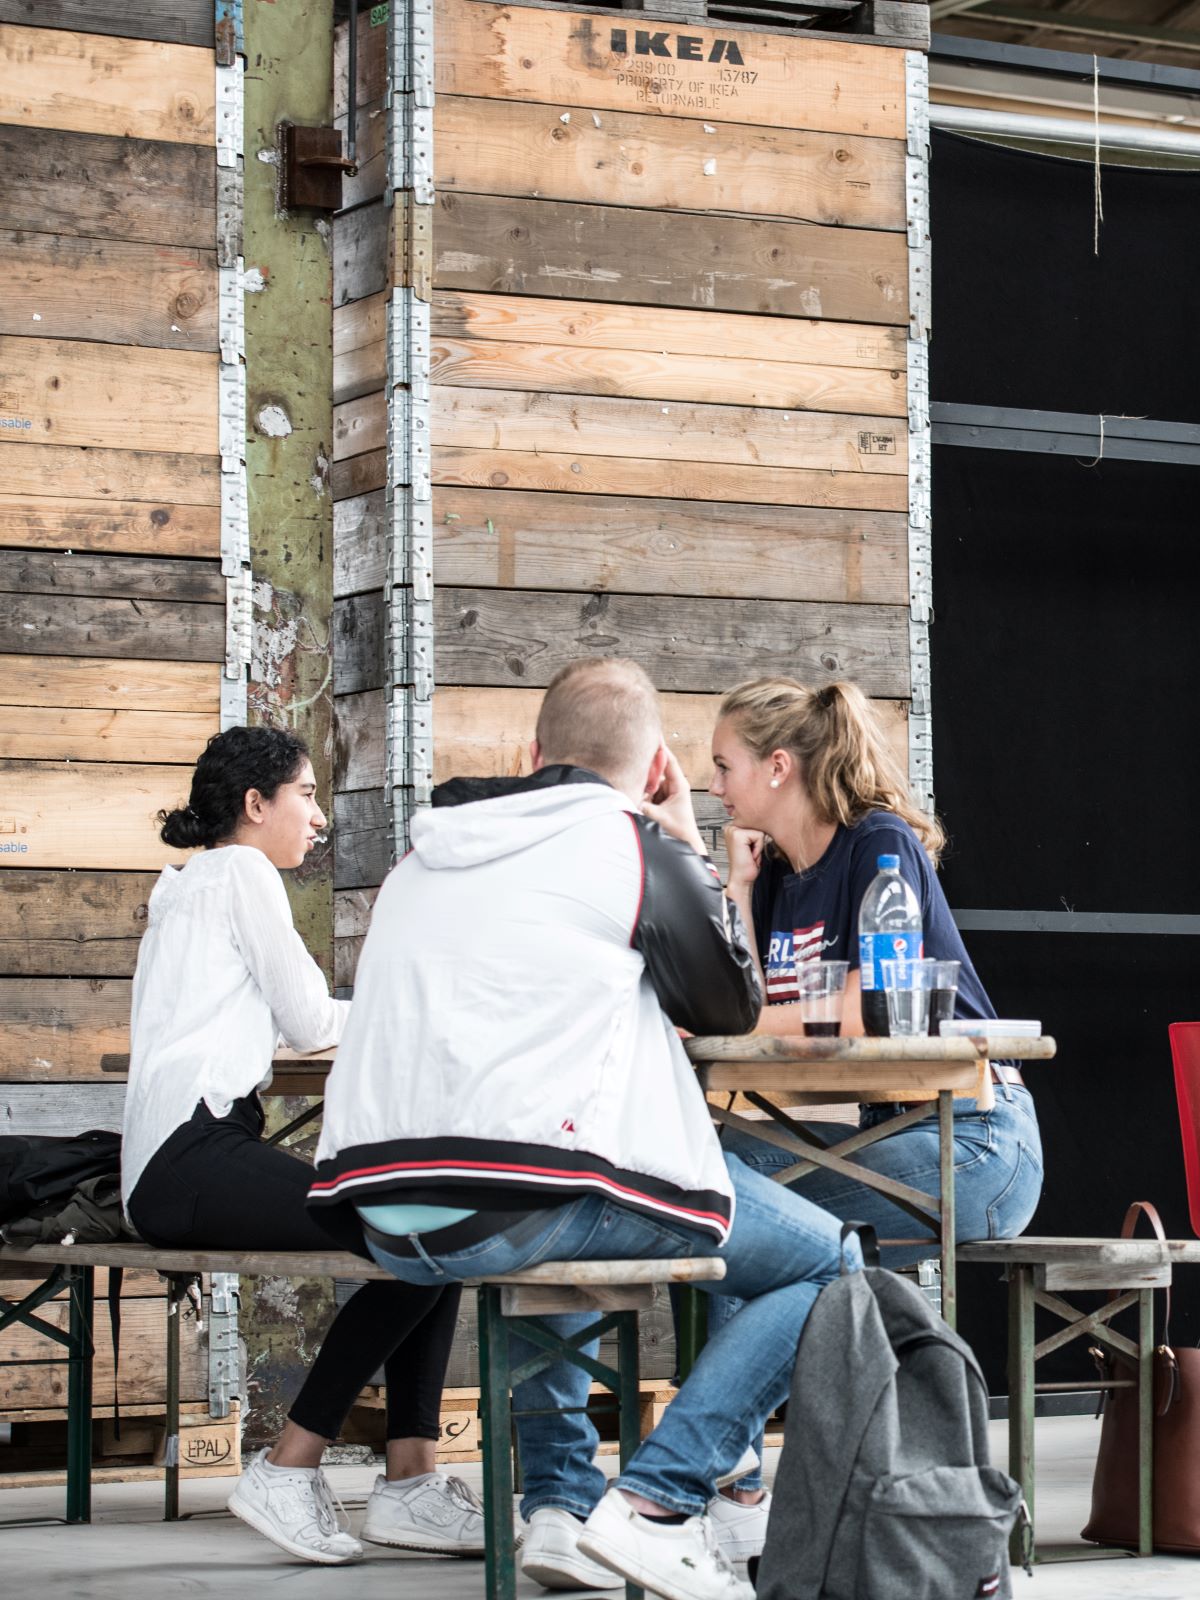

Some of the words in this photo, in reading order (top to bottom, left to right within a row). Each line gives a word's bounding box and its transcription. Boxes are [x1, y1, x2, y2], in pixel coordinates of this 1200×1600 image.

[611, 28, 745, 66] IKEA
[616, 73, 684, 92] PROPERTY
[688, 82, 705, 93] OF
[709, 84, 739, 97] IKEA
[636, 91, 721, 110] RETURNABLE
[0, 417, 31, 429] sable
[188, 1438, 224, 1458] EPAL
